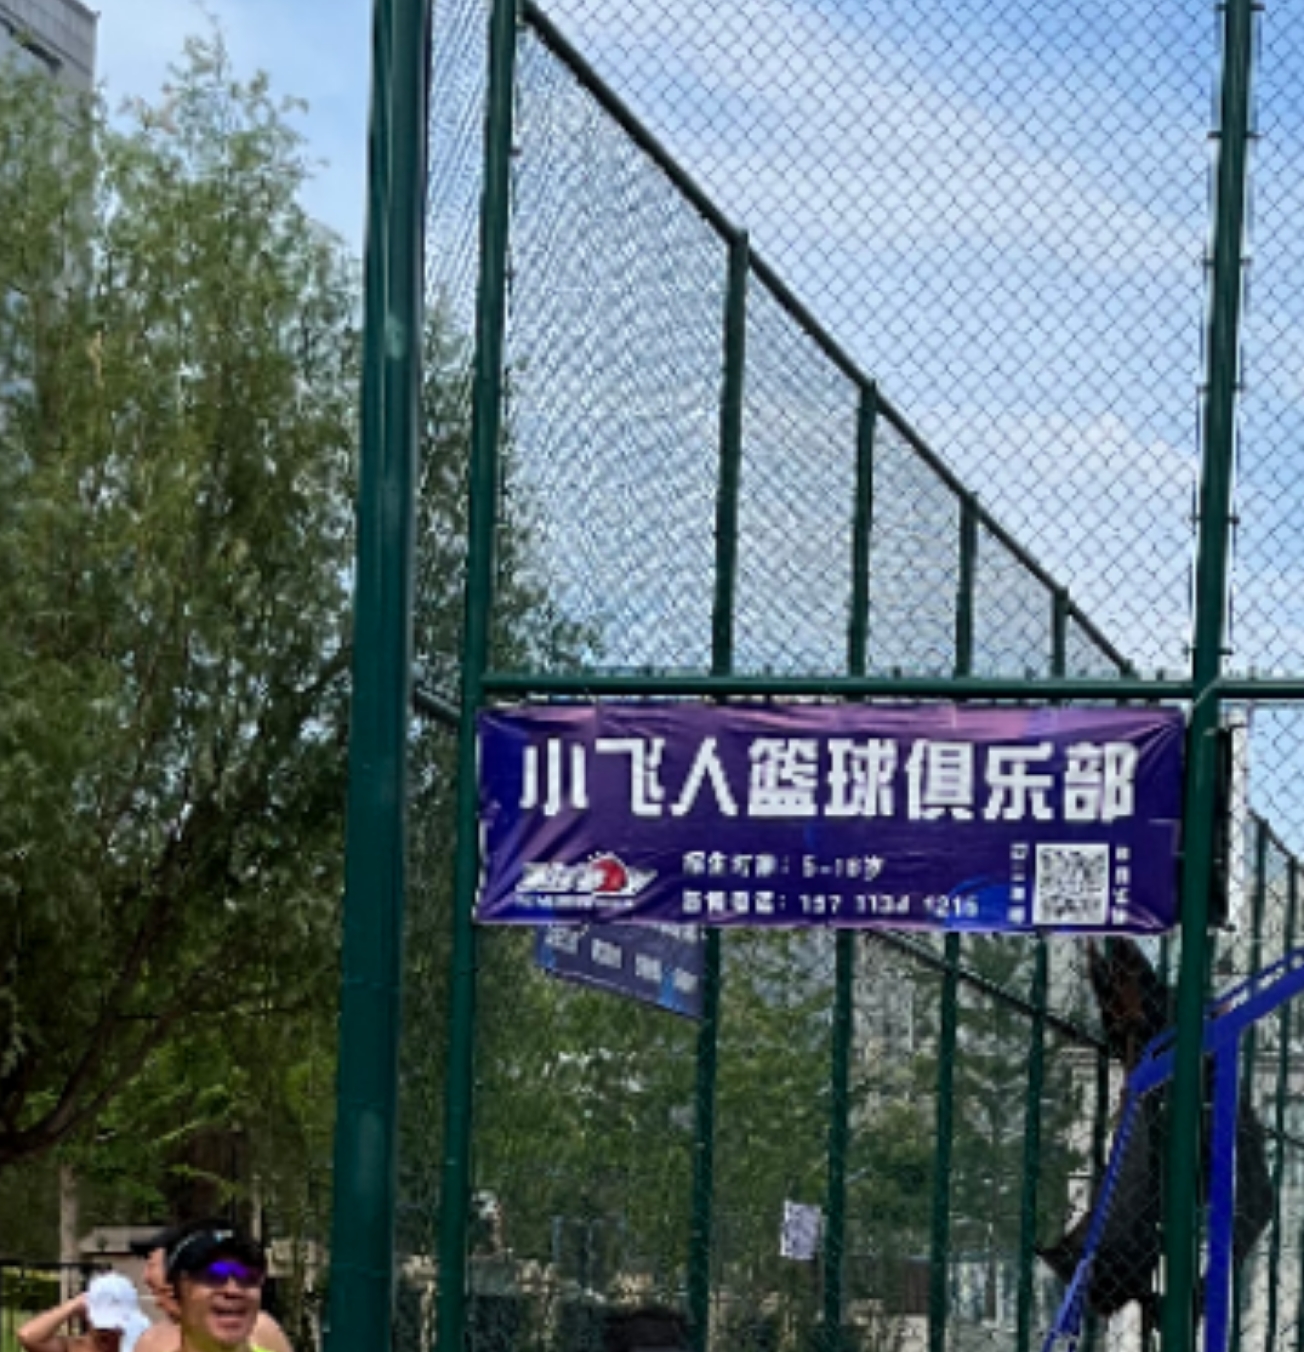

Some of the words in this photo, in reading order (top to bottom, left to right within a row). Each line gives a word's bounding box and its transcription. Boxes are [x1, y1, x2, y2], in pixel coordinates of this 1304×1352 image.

[519, 736, 1139, 822] 小飞人篮球俱乐部
